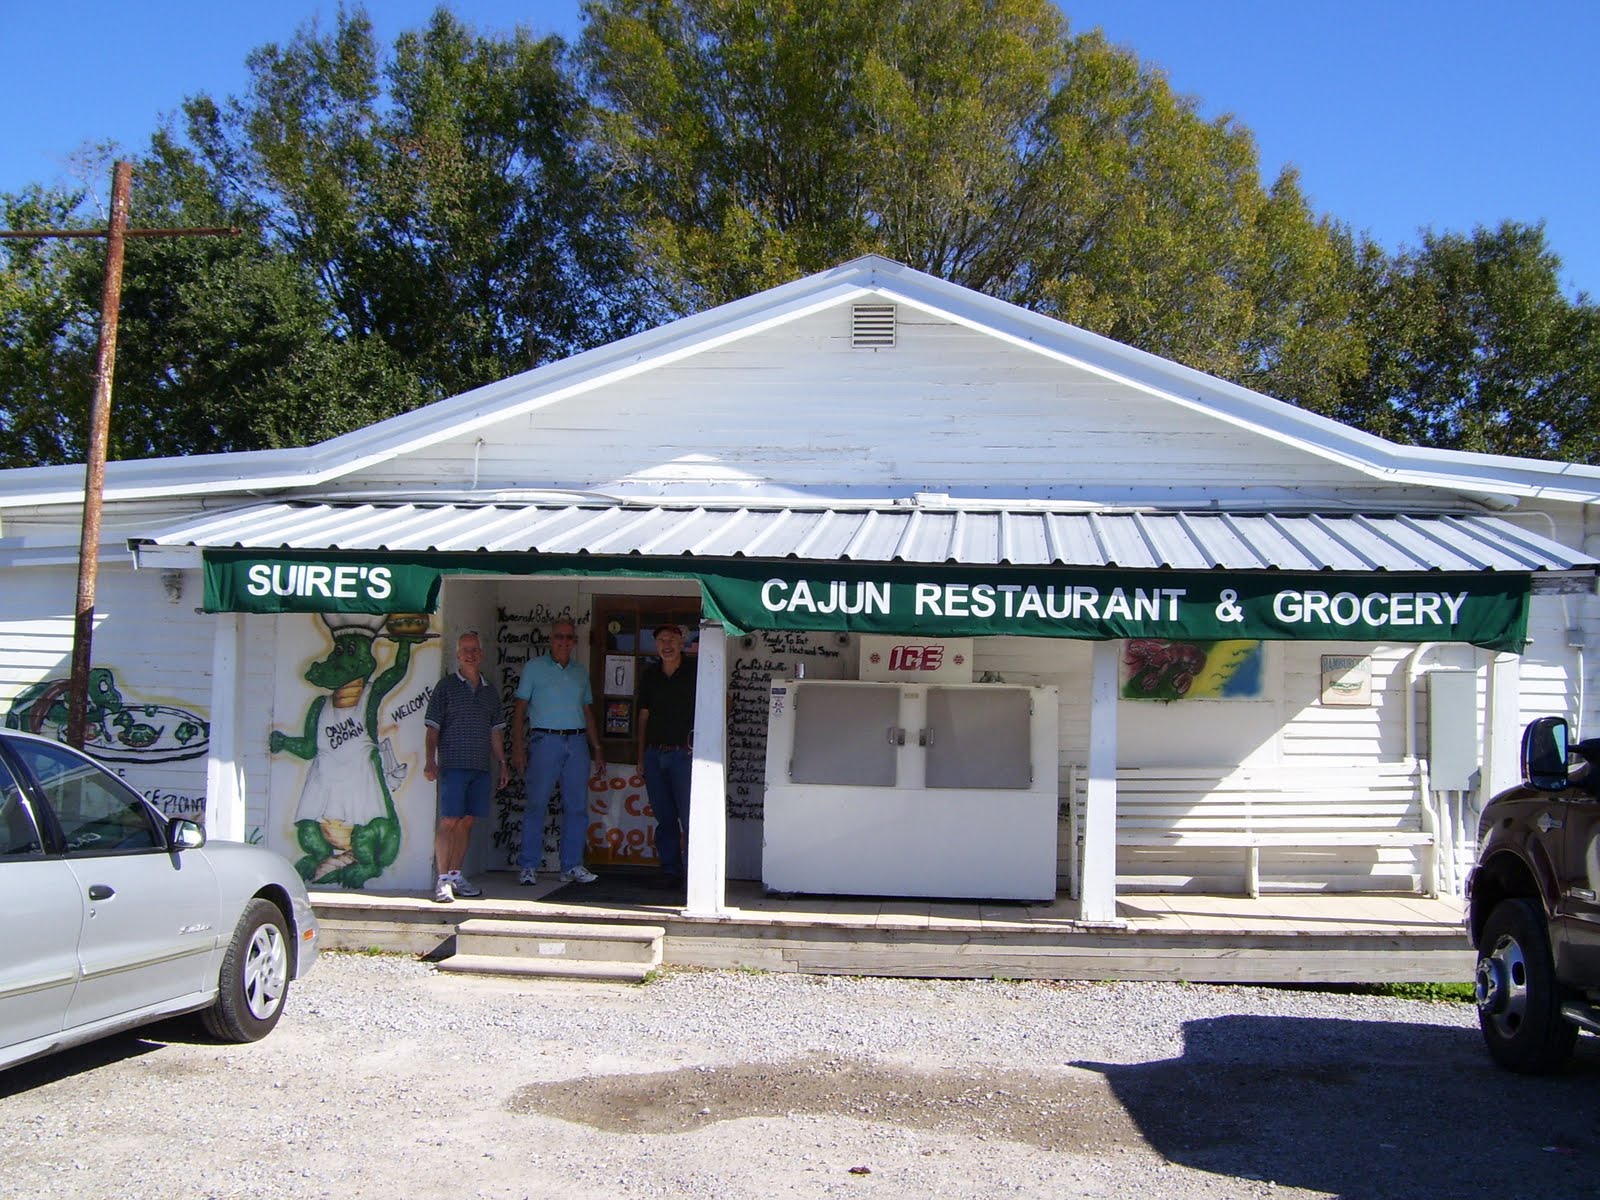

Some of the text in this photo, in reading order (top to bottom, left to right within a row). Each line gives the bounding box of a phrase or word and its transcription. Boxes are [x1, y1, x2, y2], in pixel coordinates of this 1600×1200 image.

[247, 564, 392, 599] SUIRE'S
[761, 579, 1469, 627] CAJUN RESTAURANT & GROCERY
[888, 646, 944, 671] ICE
[392, 686, 433, 722] WELCOME
[325, 717, 355, 738] CAJUN
[330, 722, 364, 749] COOKIN
